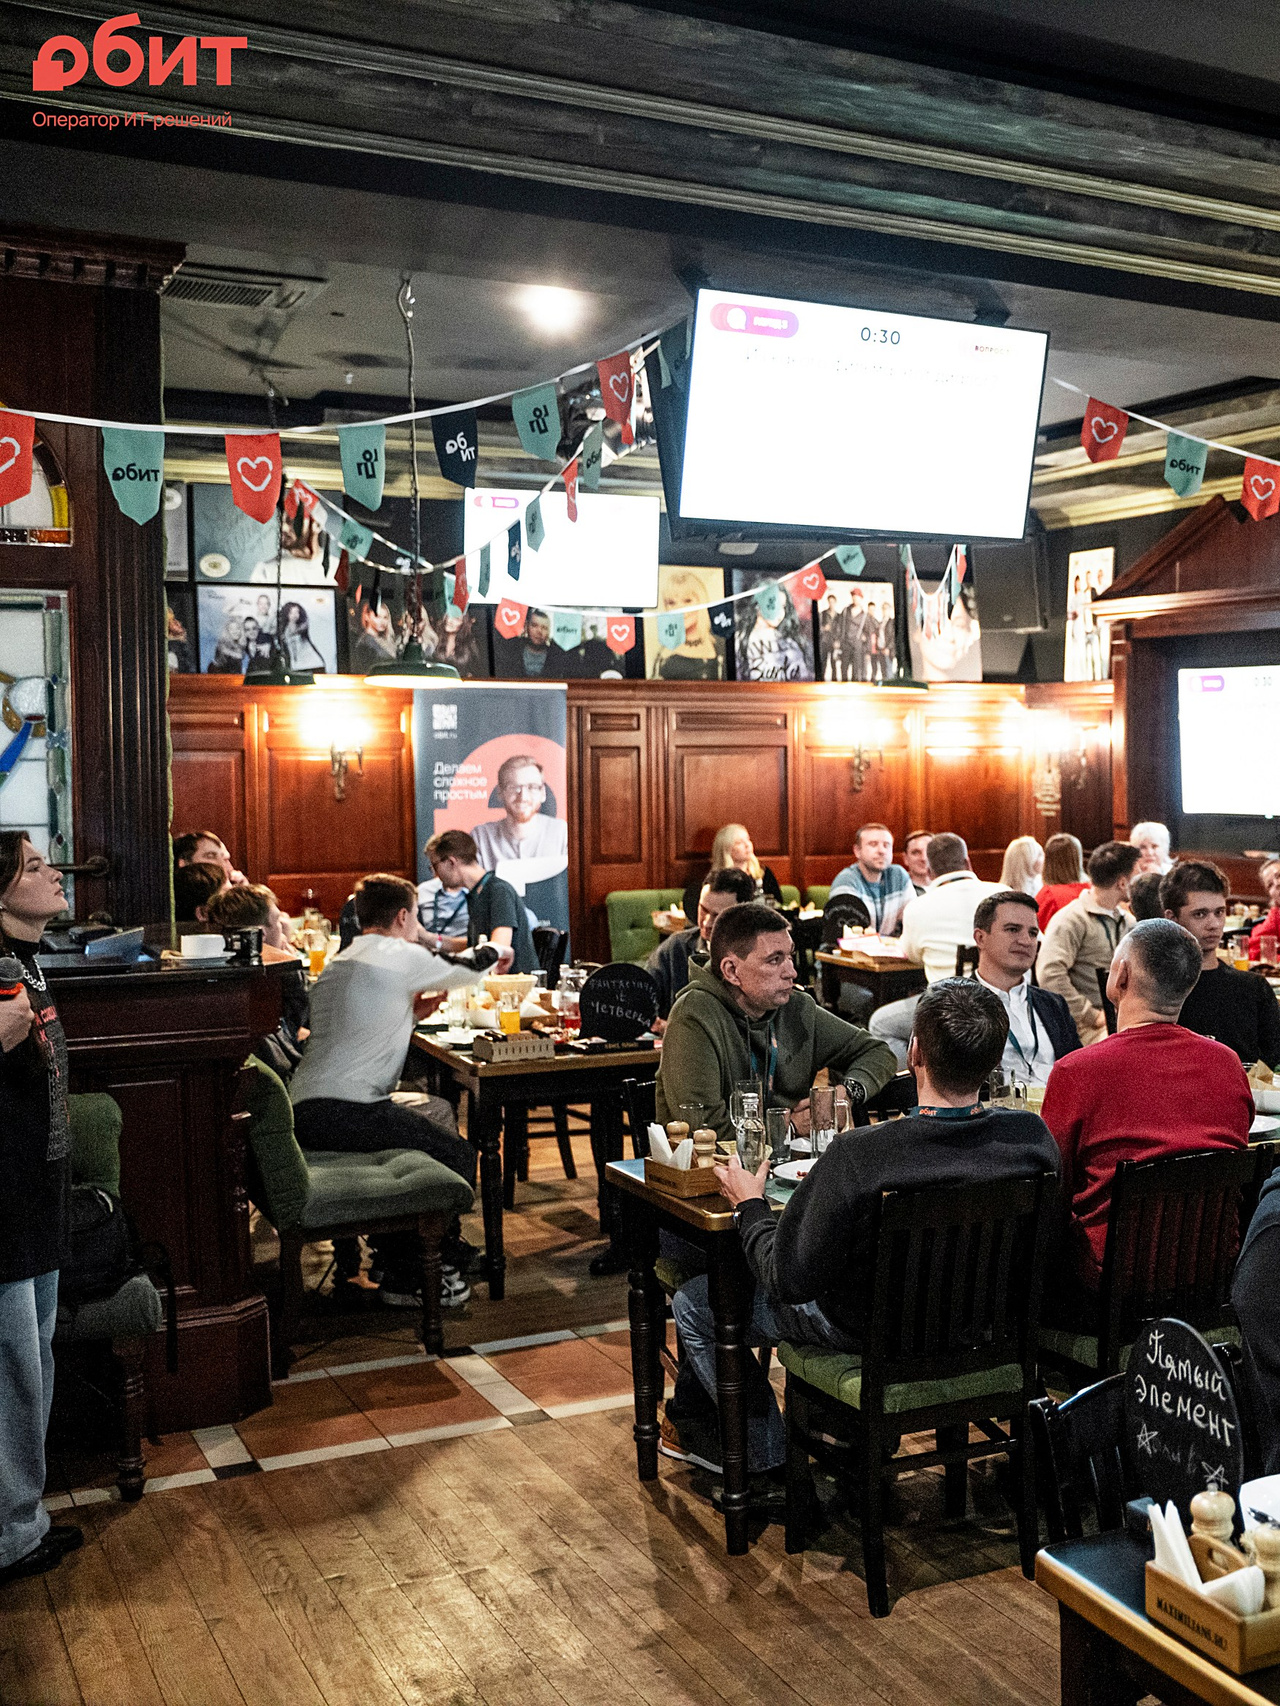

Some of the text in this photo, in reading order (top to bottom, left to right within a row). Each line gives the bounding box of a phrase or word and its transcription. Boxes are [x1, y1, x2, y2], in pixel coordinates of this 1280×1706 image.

[860, 327, 901, 346] 0:30
[112, 463, 160, 482] обит
[1170, 458, 1201, 476] обит
[433, 761, 482, 776] Делаем
[433, 776, 487, 788] сложное
[433, 789, 487, 803] простым
